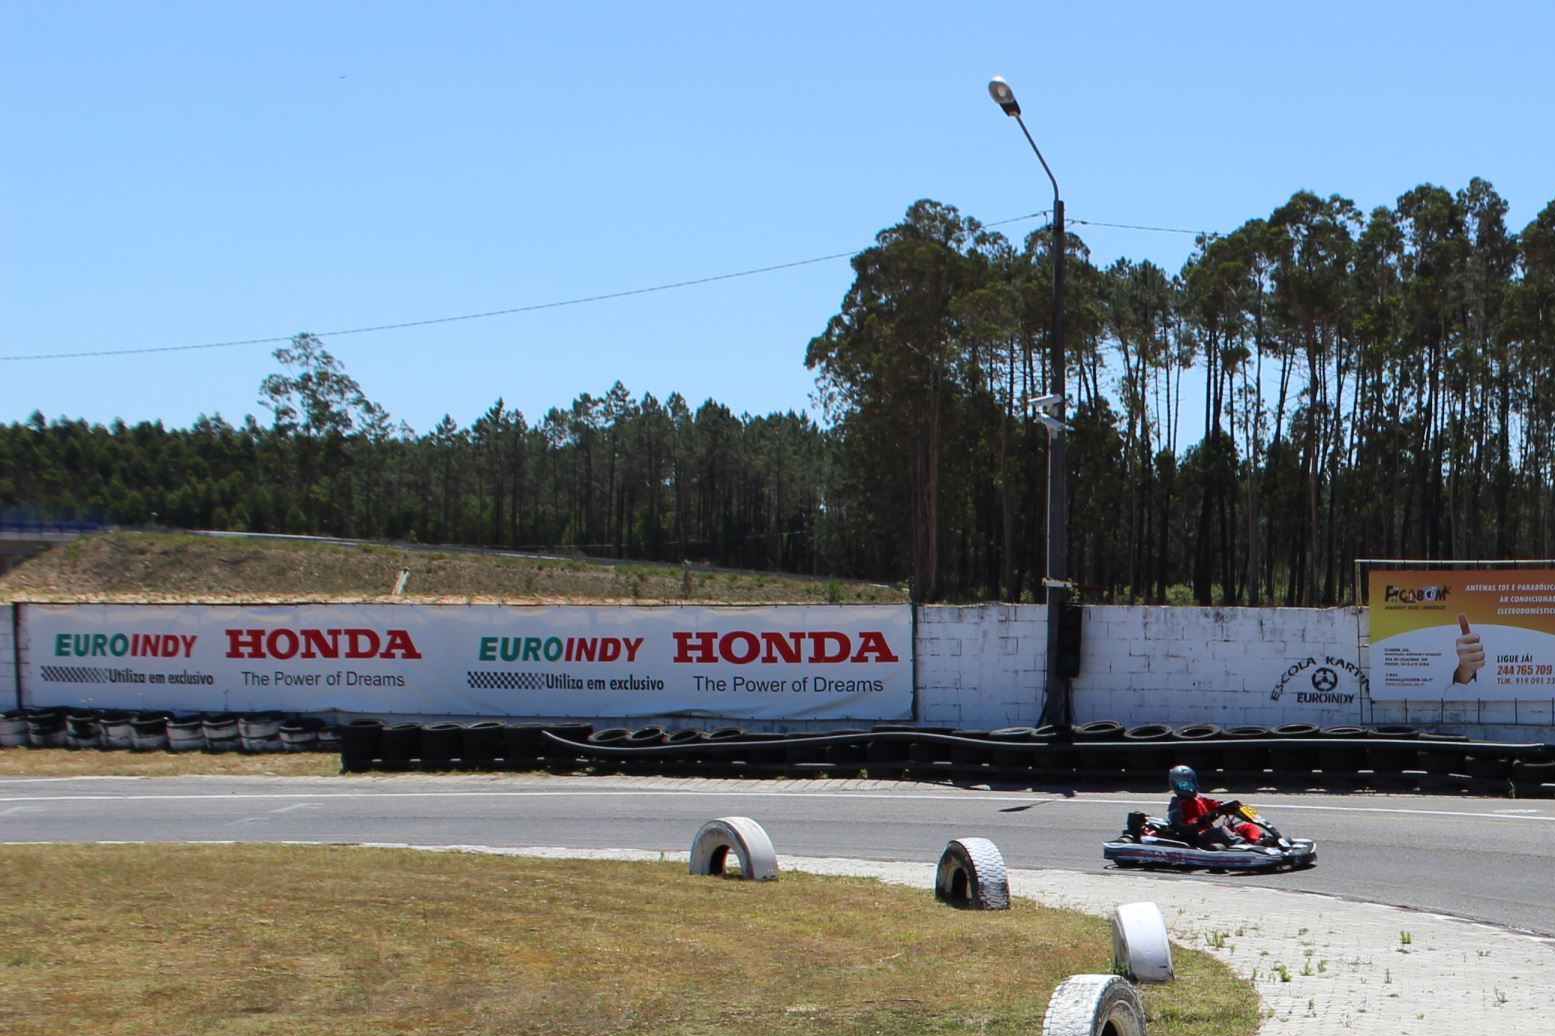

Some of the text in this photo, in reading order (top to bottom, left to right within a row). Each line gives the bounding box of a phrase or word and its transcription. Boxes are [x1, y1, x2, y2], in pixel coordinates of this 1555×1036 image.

[1465, 584, 1496, 592] ANTENAS
[55, 632, 197, 658] EUROINDY
[225, 629, 422, 660] HONDA
[478, 636, 644, 662] EUROINDY
[673, 631, 899, 664] HONDA
[108, 668, 214, 686] Utiliza em exclusivo
[1270, 656, 1317, 702] ESCOLA
[1497, 665, 1553, 675] 244 765 709
[242, 671, 405, 688] The Power of Dreams
[545, 673, 664, 691] Utiliza em exclusivo
[694, 676, 884, 693] The Power of Dreams
[1297, 692, 1354, 704] EUROINDY
